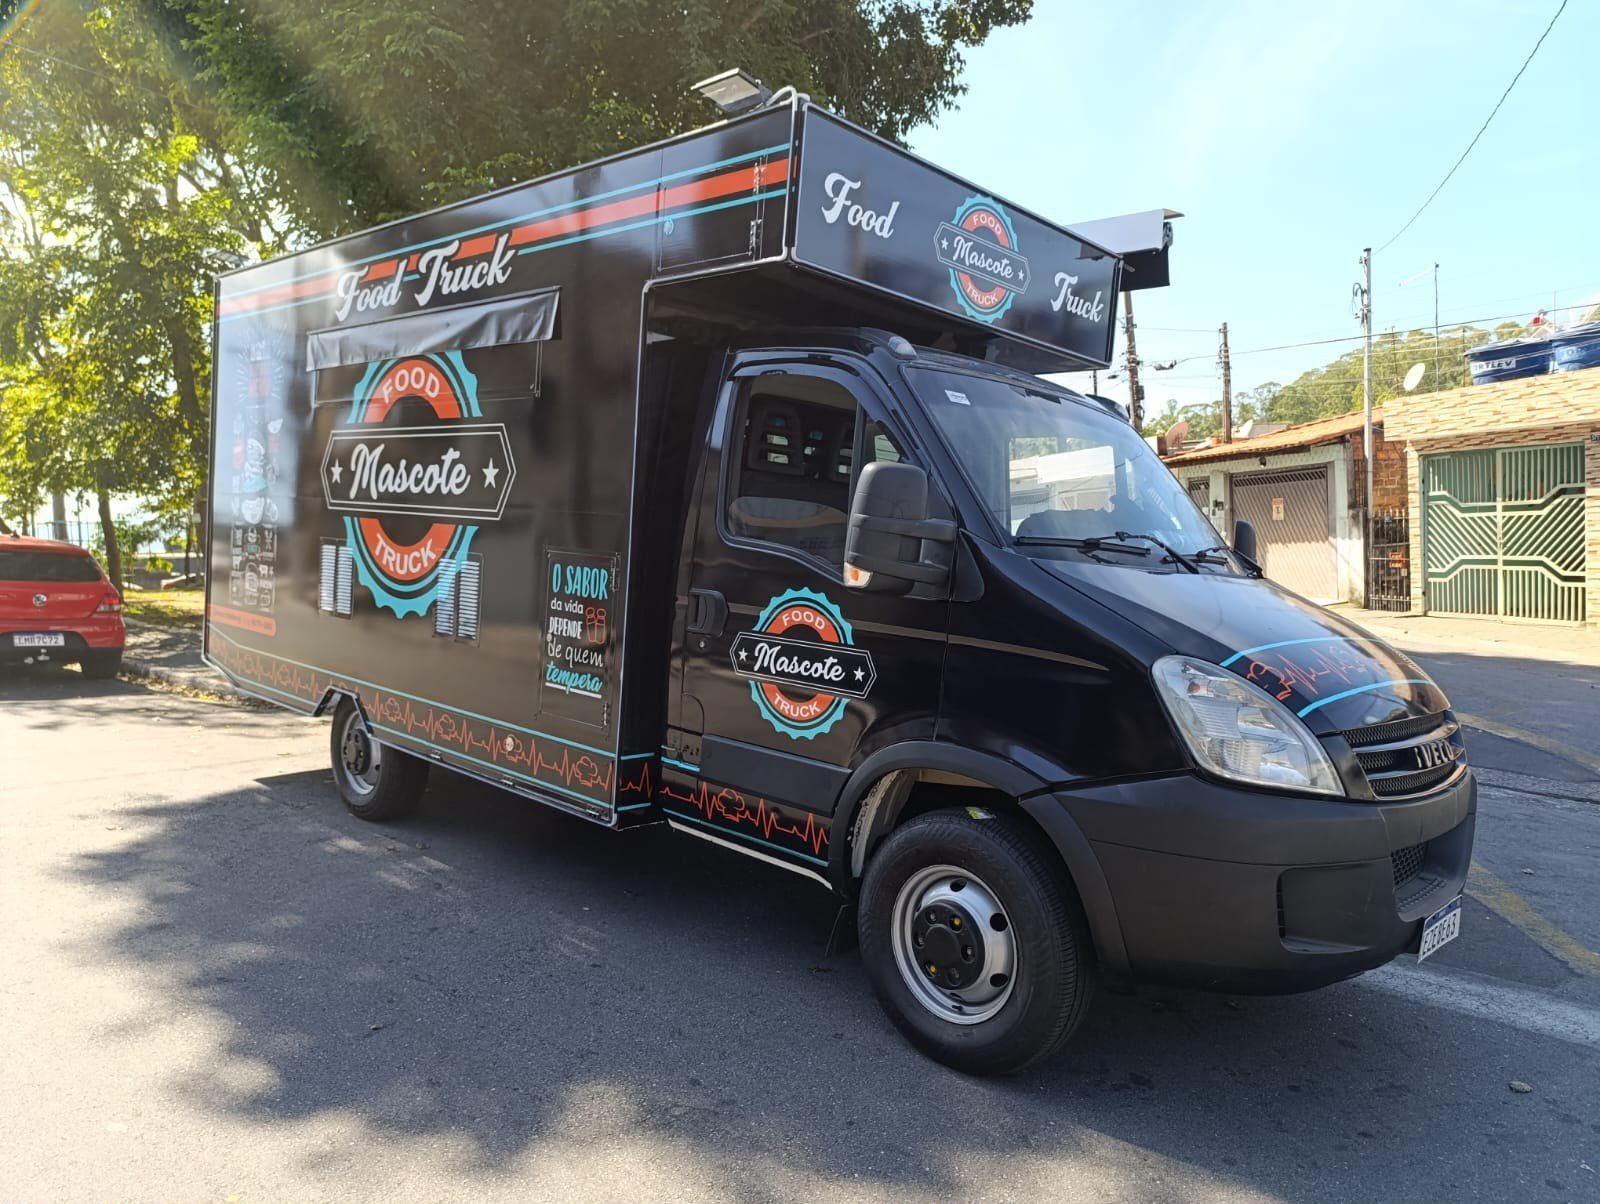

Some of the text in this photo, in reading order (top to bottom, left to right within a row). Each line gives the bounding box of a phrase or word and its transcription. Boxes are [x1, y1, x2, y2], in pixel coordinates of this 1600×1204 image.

[972, 214, 1002, 235] FOOD
[821, 172, 1104, 323] Food Truck
[952, 236, 1014, 279] Mascote
[336, 233, 516, 322] Food Truck
[967, 283, 998, 305] TRUCK
[382, 366, 440, 405] FOOD
[349, 443, 470, 500] Mascote
[374, 533, 437, 575] TRUCK
[552, 563, 609, 600] O SABOR
[551, 597, 584, 615] da vida
[782, 610, 826, 630] FOOD
[549, 616, 583, 640] DEPENDE
[548, 637, 604, 668] de quem
[753, 642, 845, 682] Mascote
[546, 661, 603, 694] tempera
[773, 693, 821, 718] TRUCK
[1414, 740, 1455, 769] IVECO
